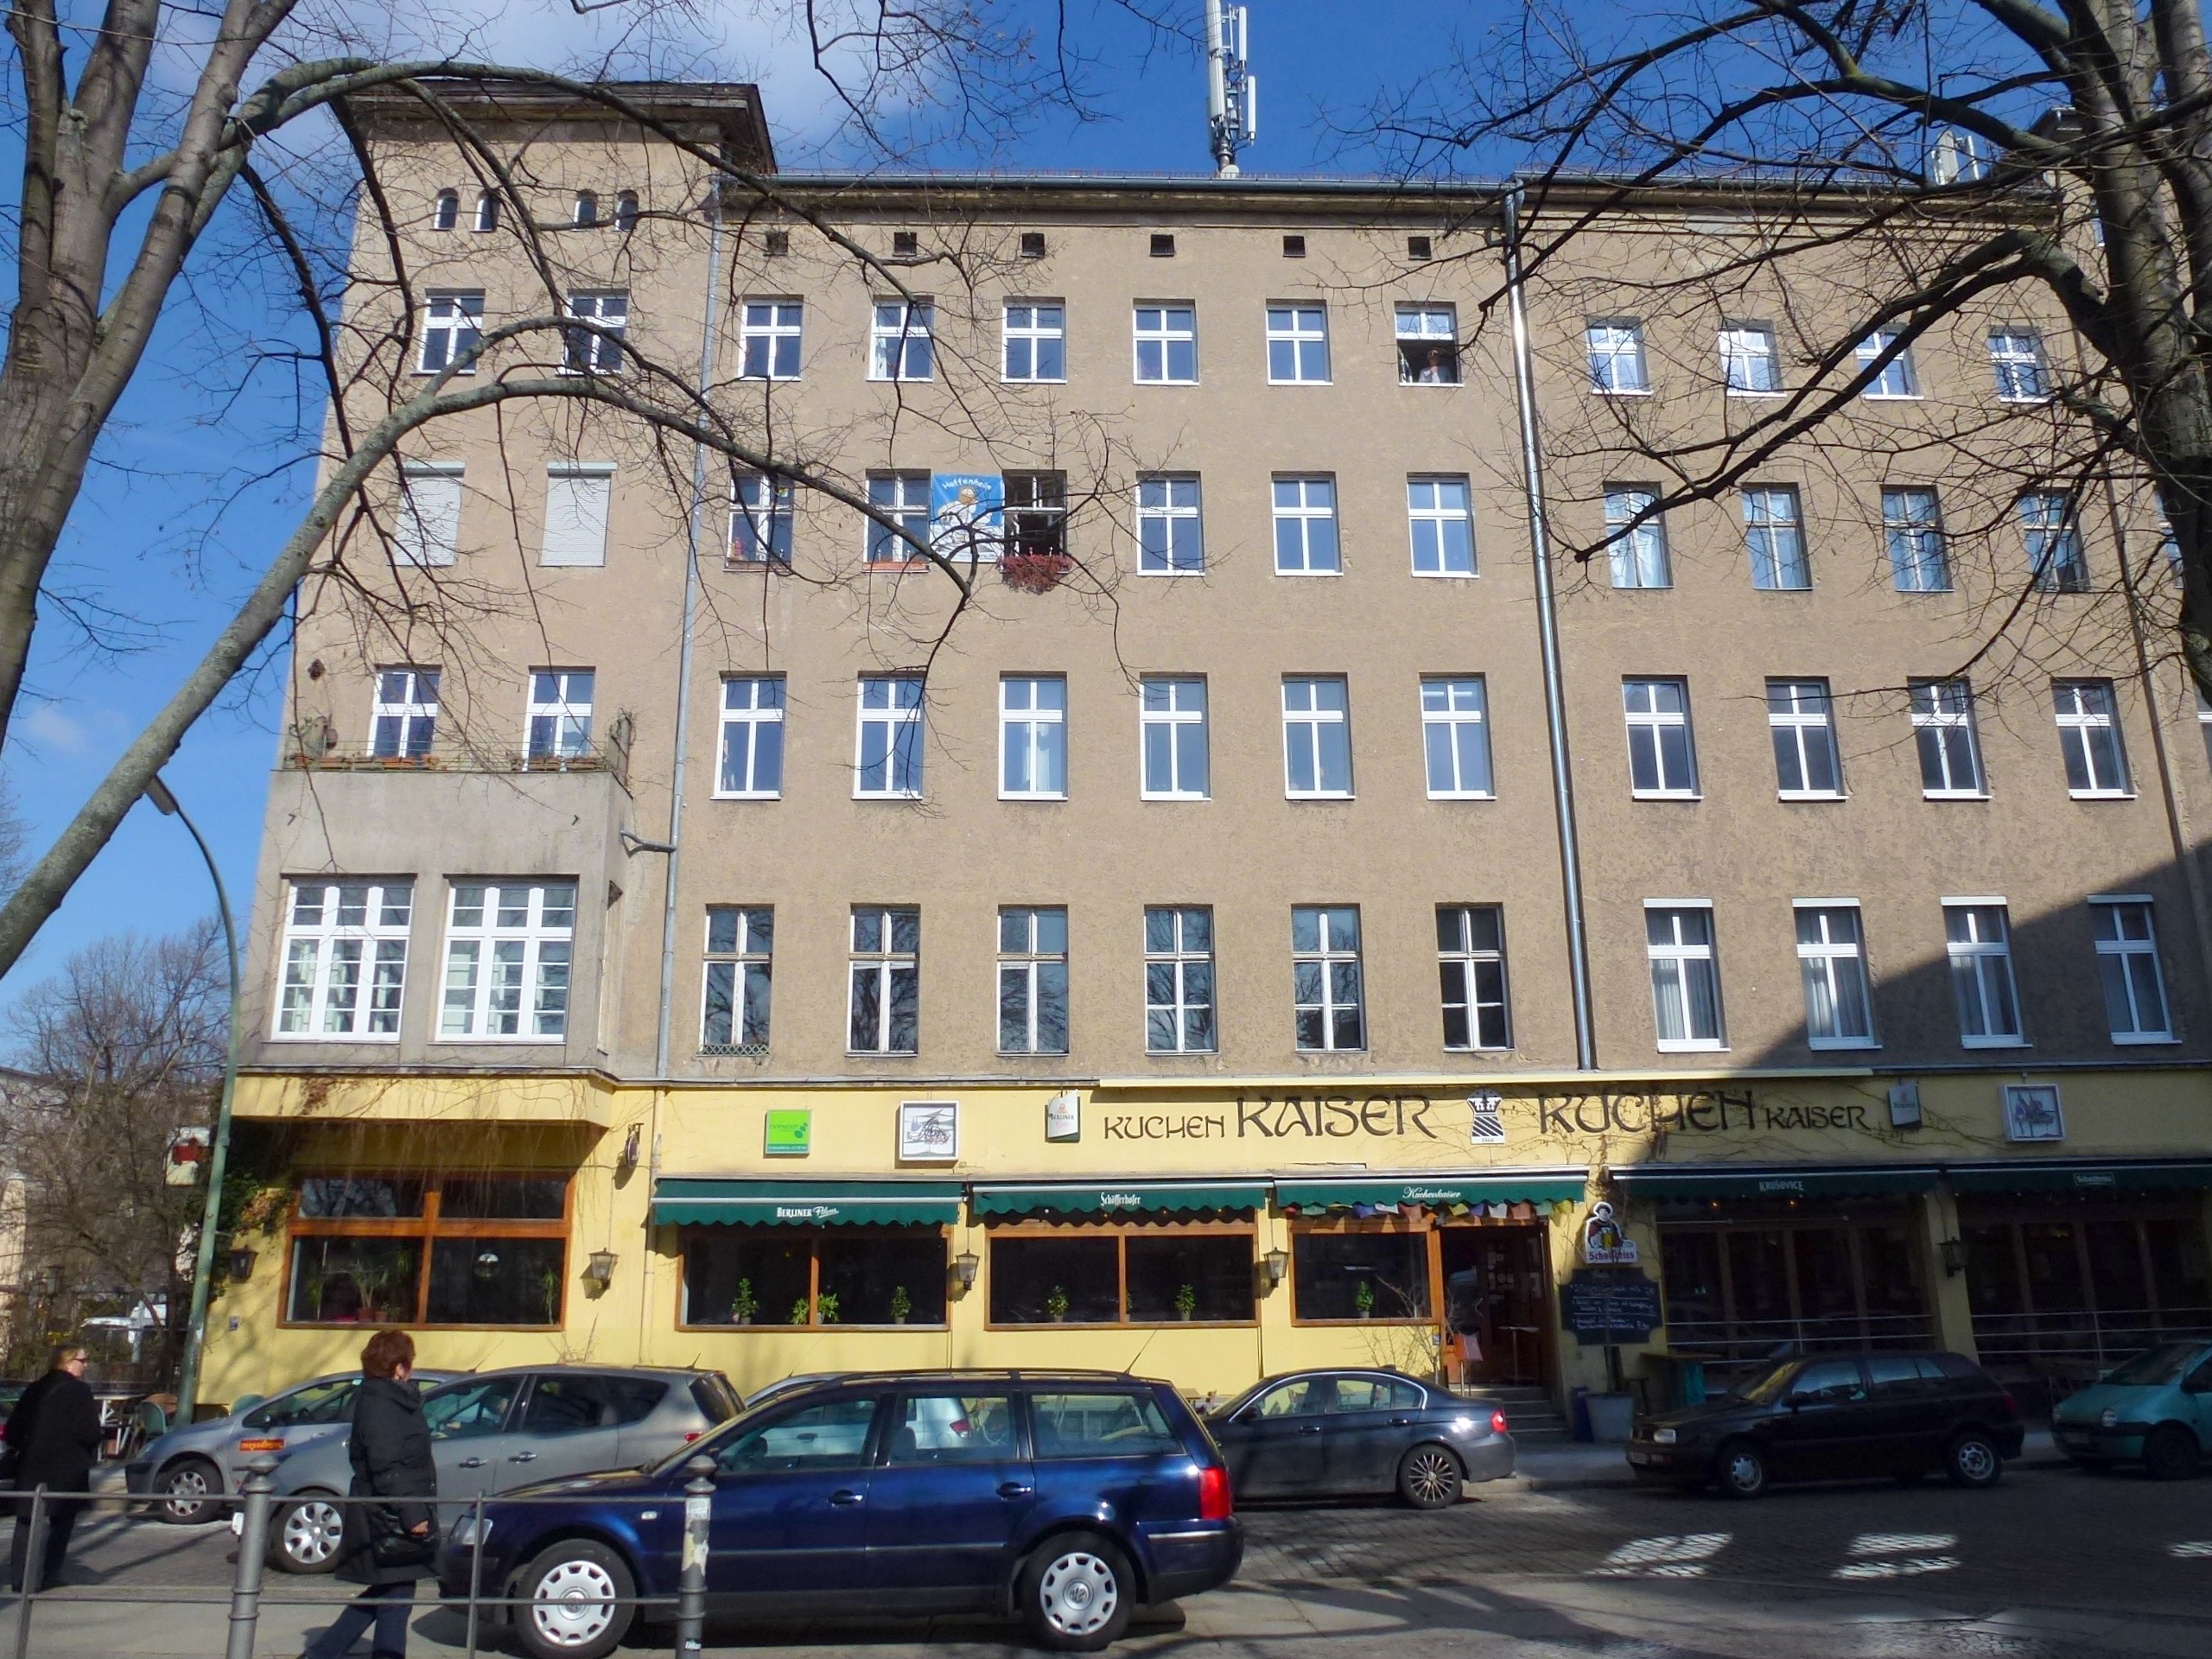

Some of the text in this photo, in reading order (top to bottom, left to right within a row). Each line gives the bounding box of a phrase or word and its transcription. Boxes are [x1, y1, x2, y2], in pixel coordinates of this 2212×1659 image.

[1104, 1095, 1438, 1139] KUCHEN KAISER
[1536, 1090, 1873, 1134] KUCHEN KAISER
[777, 1206, 812, 1218] BERLINER
[1100, 1192, 1141, 1206] Schöfferhofer
